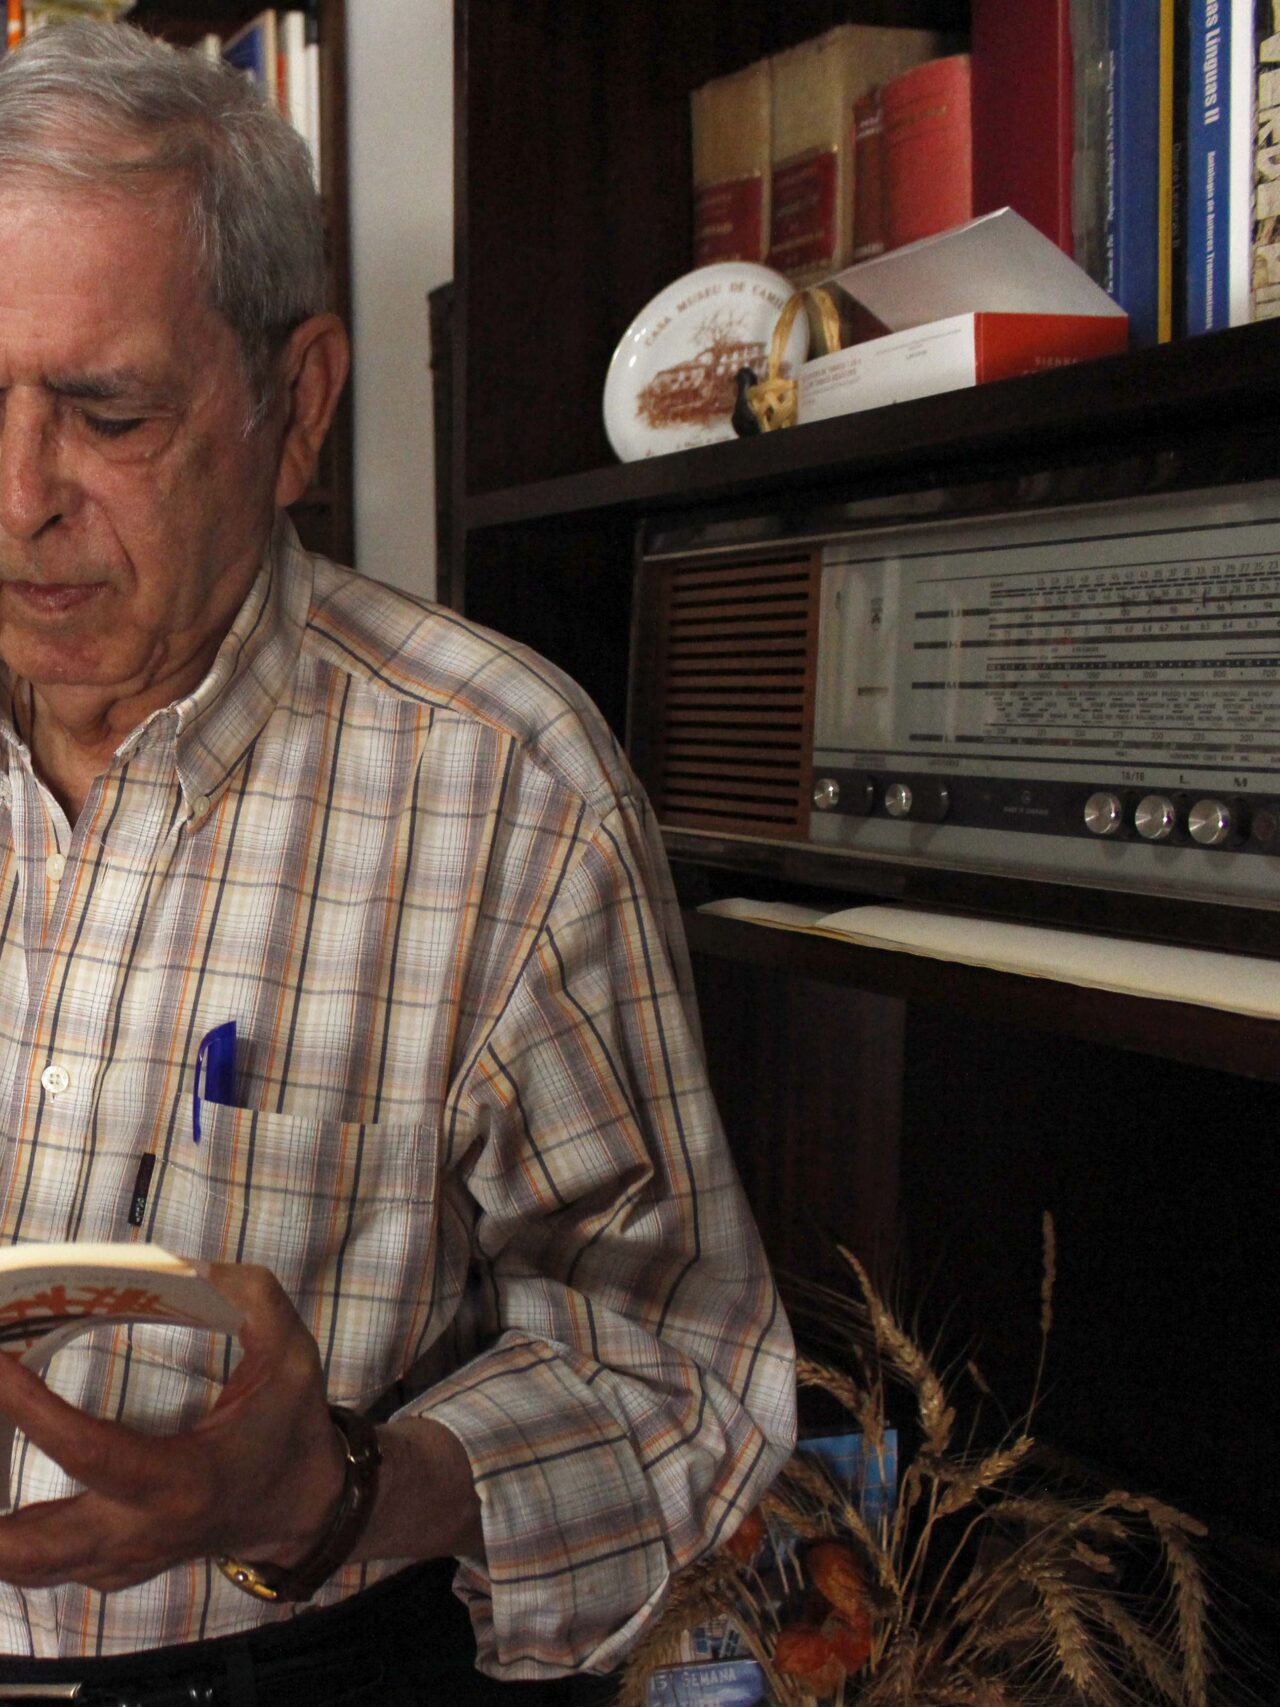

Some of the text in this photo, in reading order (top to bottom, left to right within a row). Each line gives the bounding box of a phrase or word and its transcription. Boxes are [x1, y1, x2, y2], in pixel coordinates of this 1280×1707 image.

[1203, 27, 1221, 108] Línguas
[1204, 106, 1220, 126] II
[1205, 150, 1216, 330] Antologia de Autores Transmontanos
[646, 281, 786, 346] CASA MUSEU DE CAMI
[682, 1667, 737, 1688] SEMANA
